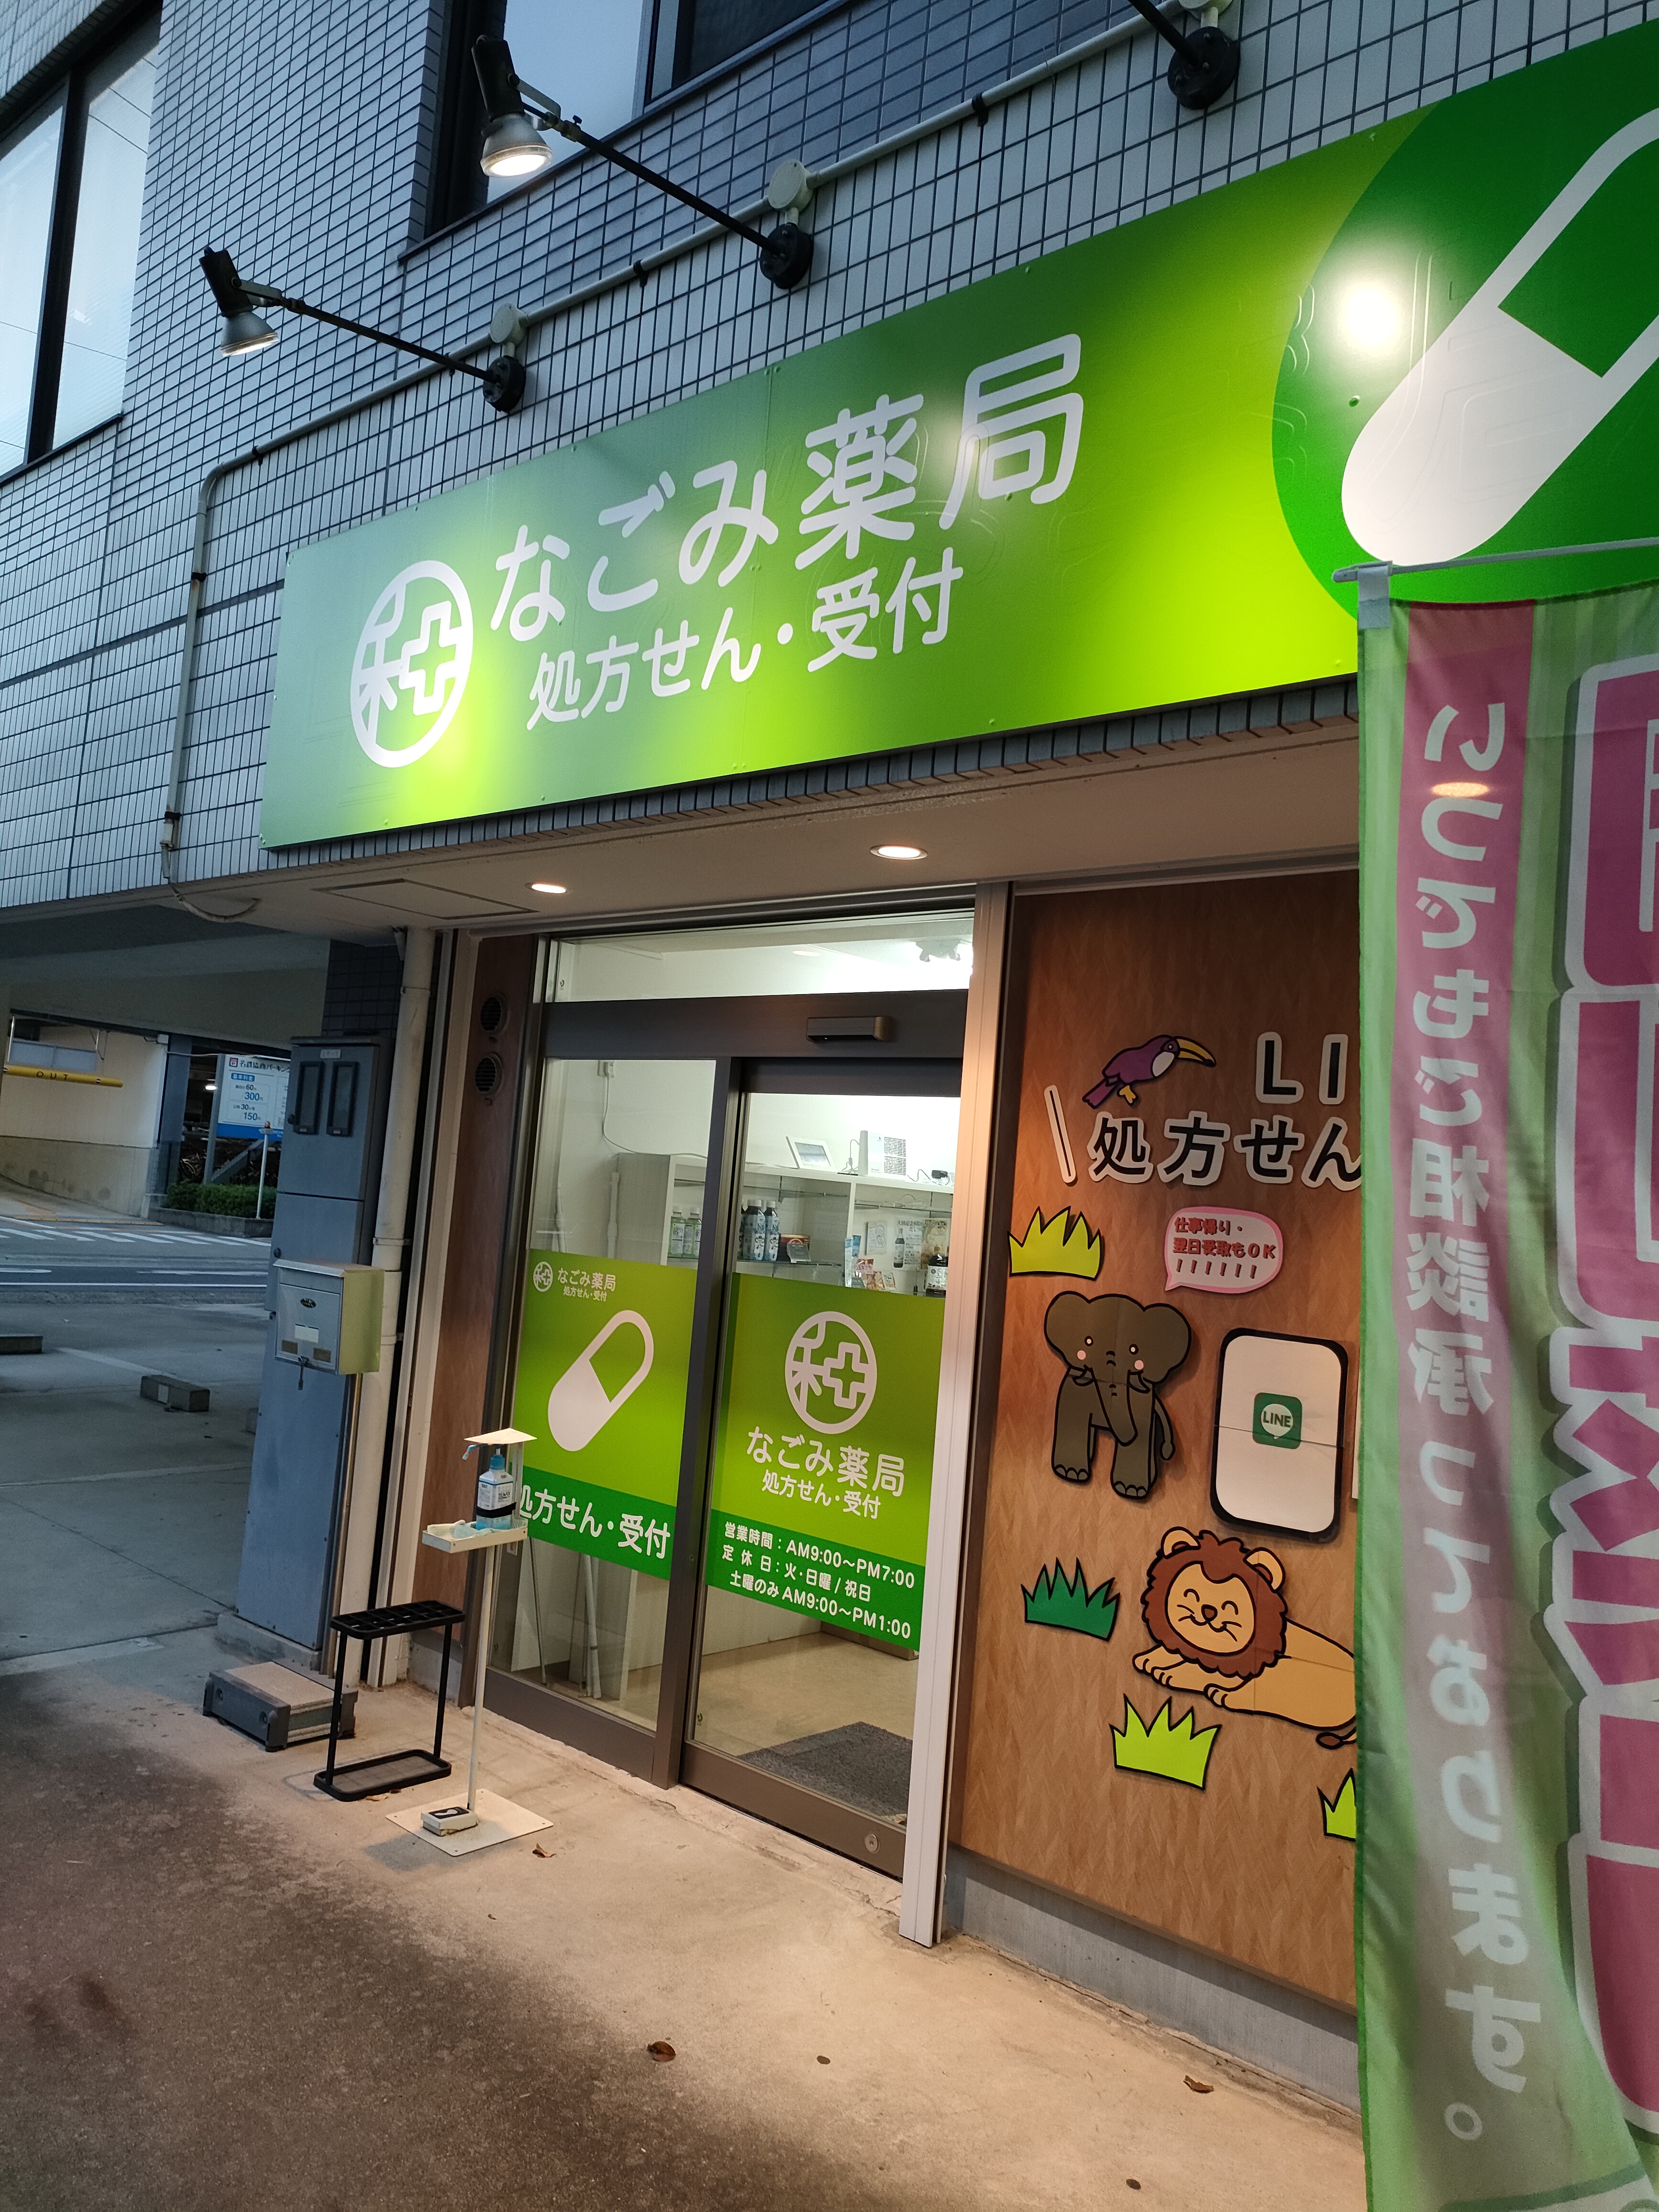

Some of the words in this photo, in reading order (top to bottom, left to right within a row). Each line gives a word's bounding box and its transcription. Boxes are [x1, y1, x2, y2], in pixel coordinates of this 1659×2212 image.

[491, 333, 1084, 641] なごみ薬局
[527, 547, 962, 730] 処方せん・受付
[36, 1071, 68, 1080] OUT
[1092, 1115, 1361, 1183] 処方せん
[557, 1268, 616, 1292] なごみ薬局
[563, 1285, 608, 1302] 処方せん・受付
[1263, 1411, 1291, 1428] LINE
[747, 1426, 905, 1497] なごみ薬局
[762, 1469, 881, 1519] 処方せん・受付
